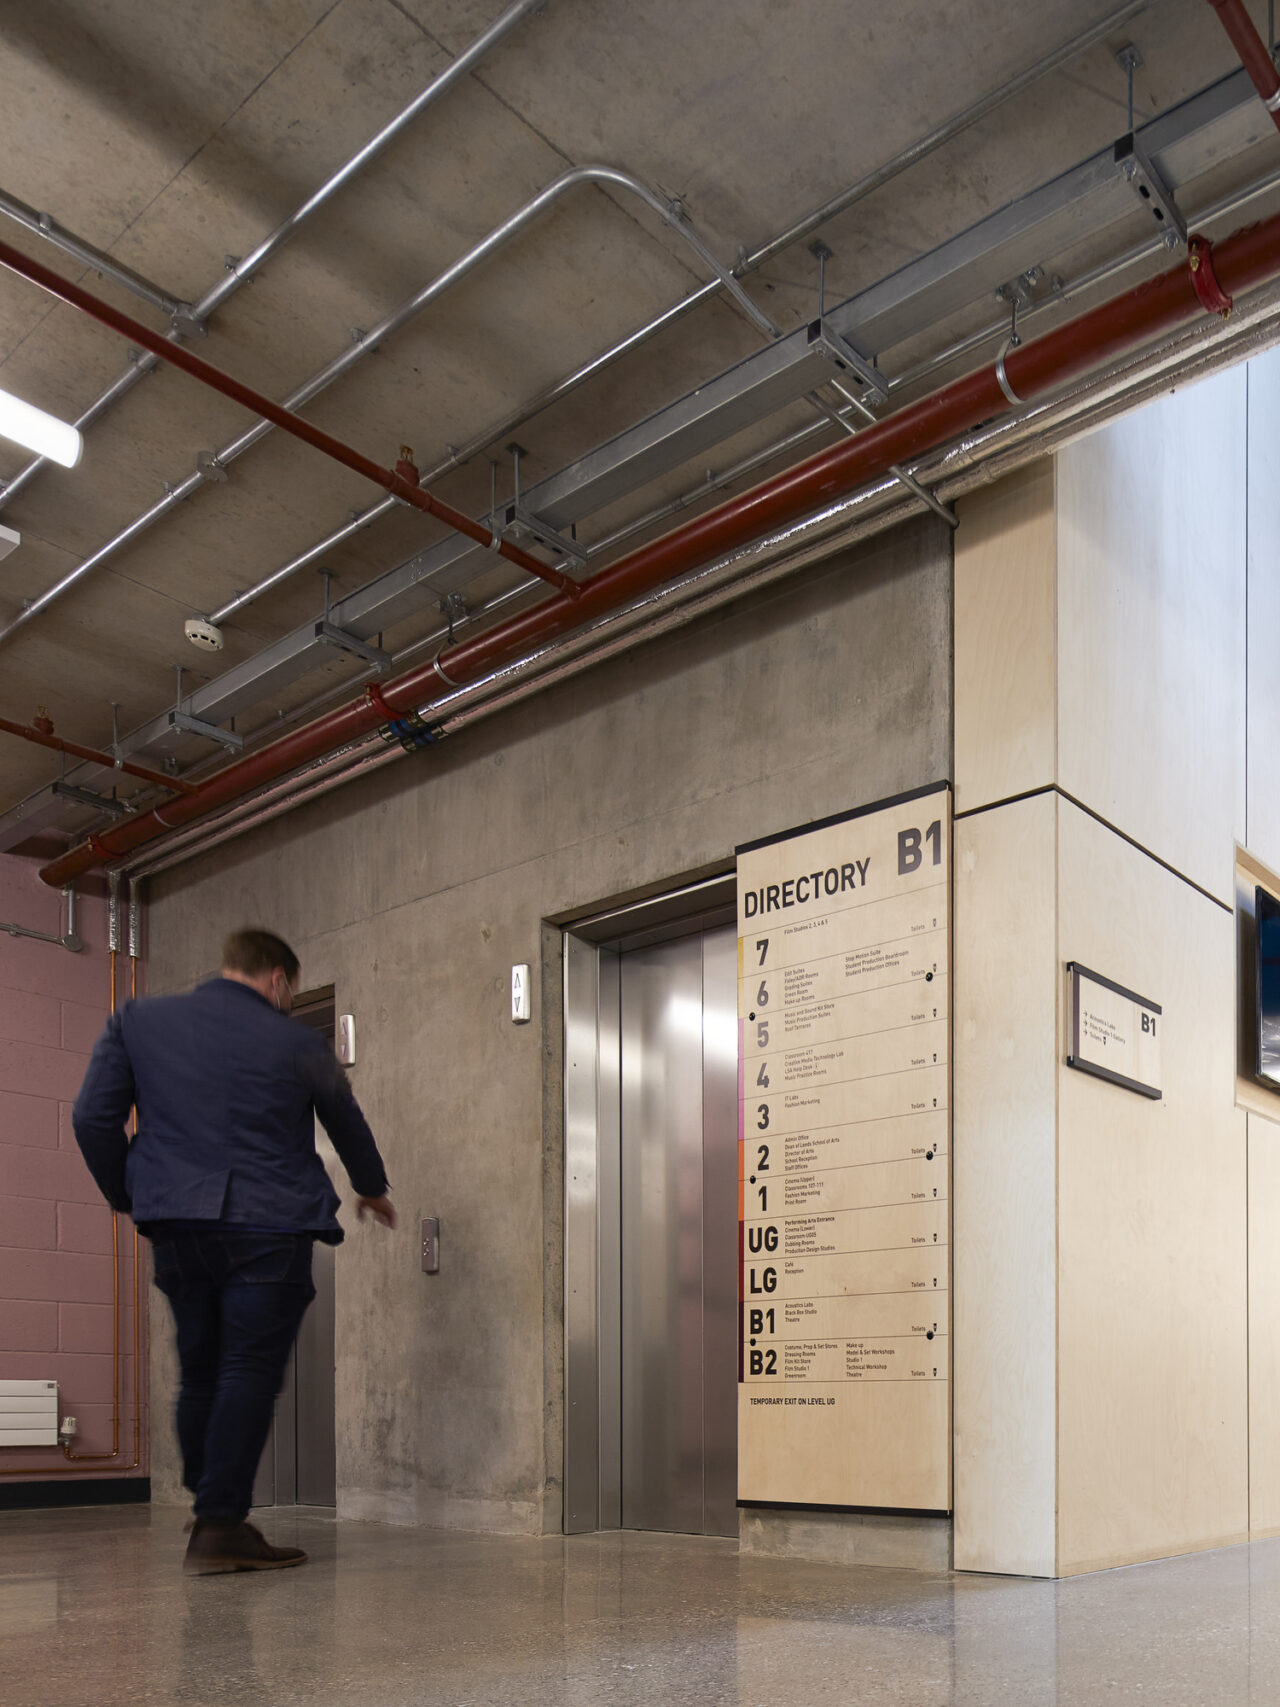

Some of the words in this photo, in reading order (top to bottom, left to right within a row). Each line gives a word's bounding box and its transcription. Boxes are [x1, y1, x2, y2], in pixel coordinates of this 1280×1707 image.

[898, 820, 941, 876] B1
[745, 857, 871, 919] DIRECTORY
[756, 939, 769, 966] 7
[845, 962, 861, 970] Student
[862, 957, 885, 965] Production
[845, 969, 862, 977] Student
[862, 964, 885, 973] Production
[757, 980, 769, 1007] 6
[797, 1015, 818, 1023] Production
[1142, 1012, 1156, 1037] B1
[757, 1021, 769, 1048] 5
[757, 1063, 769, 1088] 4
[757, 1104, 769, 1129] 3
[757, 1145, 769, 1171] 2
[758, 1186, 767, 1211] 1
[749, 1226, 778, 1253] UG
[750, 1267, 777, 1294] LG
[750, 1308, 775, 1334] B1
[750, 1349, 777, 1375] B2
[750, 1398, 783, 1406] TEMPORARY
[785, 1398, 797, 1406] EXIT
[798, 1398, 807, 1406] ON
[808, 1398, 825, 1406] LEVEL
[827, 1398, 835, 1406] UG
